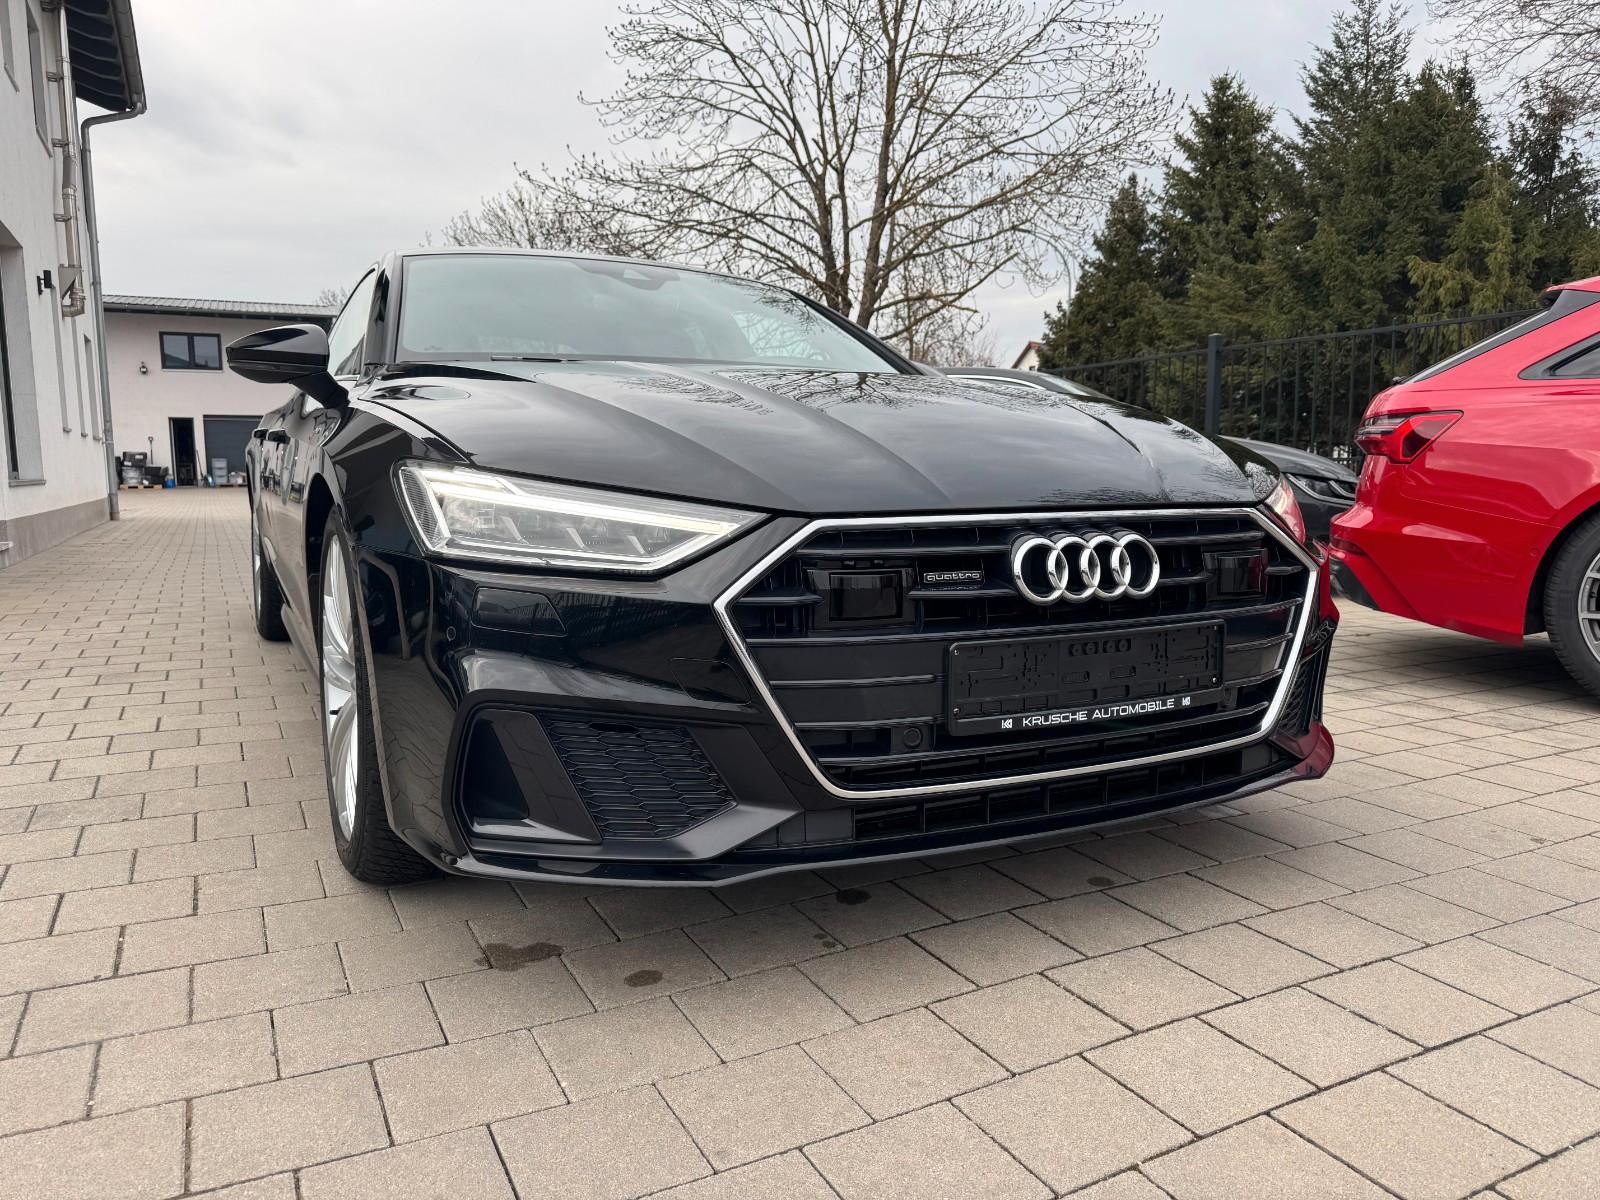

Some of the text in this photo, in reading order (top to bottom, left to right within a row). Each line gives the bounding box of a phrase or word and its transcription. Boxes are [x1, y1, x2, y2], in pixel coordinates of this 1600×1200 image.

[926, 572, 980, 582] quattro
[1022, 711, 1088, 727] KRUSCHE
[1092, 698, 1175, 719] AUTOMOBILE
